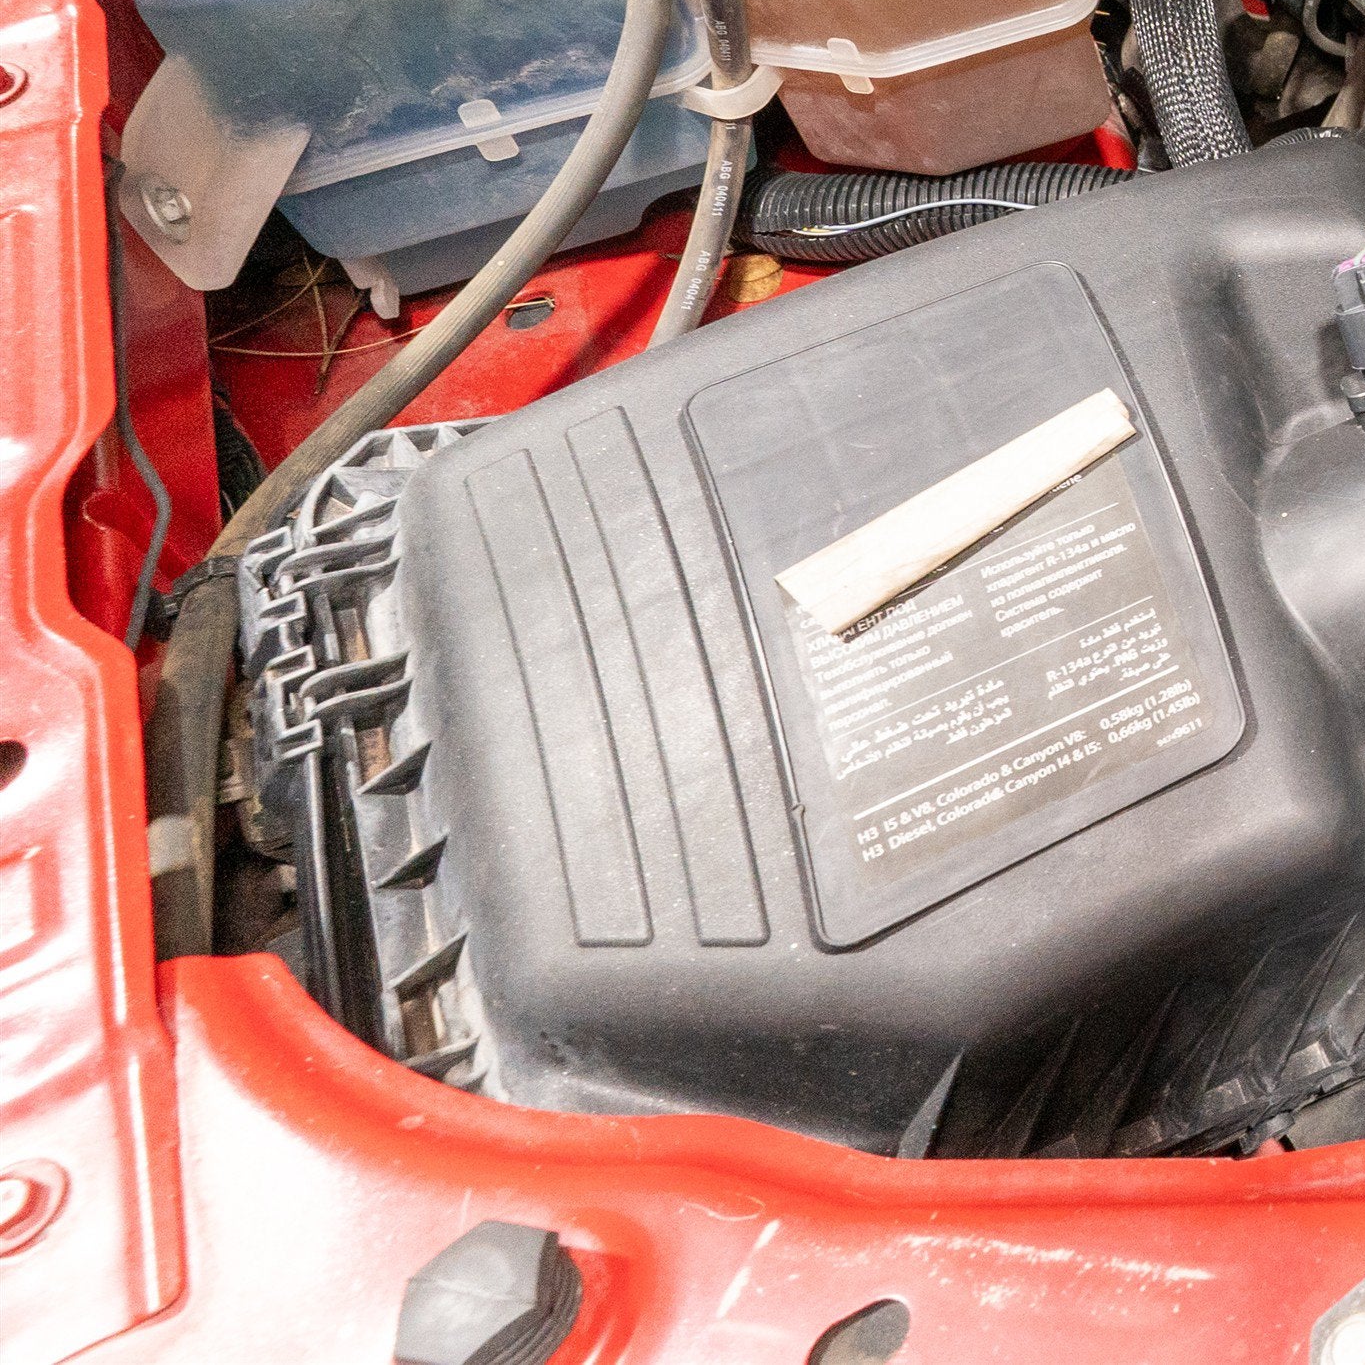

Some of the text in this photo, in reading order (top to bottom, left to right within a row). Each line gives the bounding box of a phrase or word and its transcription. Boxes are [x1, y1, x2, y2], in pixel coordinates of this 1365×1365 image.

[711, 159, 733, 217] ABG 040411
[680, 249, 712, 311] ABG 040411
[1046, 542, 1090, 567] R-134a
[882, 595, 964, 640] ДАВЛЕНИЕМ
[1046, 655, 1092, 683] R-134a
[857, 826, 880, 845] H3
[899, 811, 913, 825] &
[911, 801, 936, 818] V8,
[935, 771, 1000, 807] Colorado
[1000, 764, 1013, 777] &
[1013, 740, 1064, 770] Canyon
[1063, 729, 1088, 746] V8:
[861, 843, 885, 862] H3
[887, 819, 937, 850] Diesel,
[1004, 762, 1057, 793] Canyon
[1072, 748, 1085, 762] &
